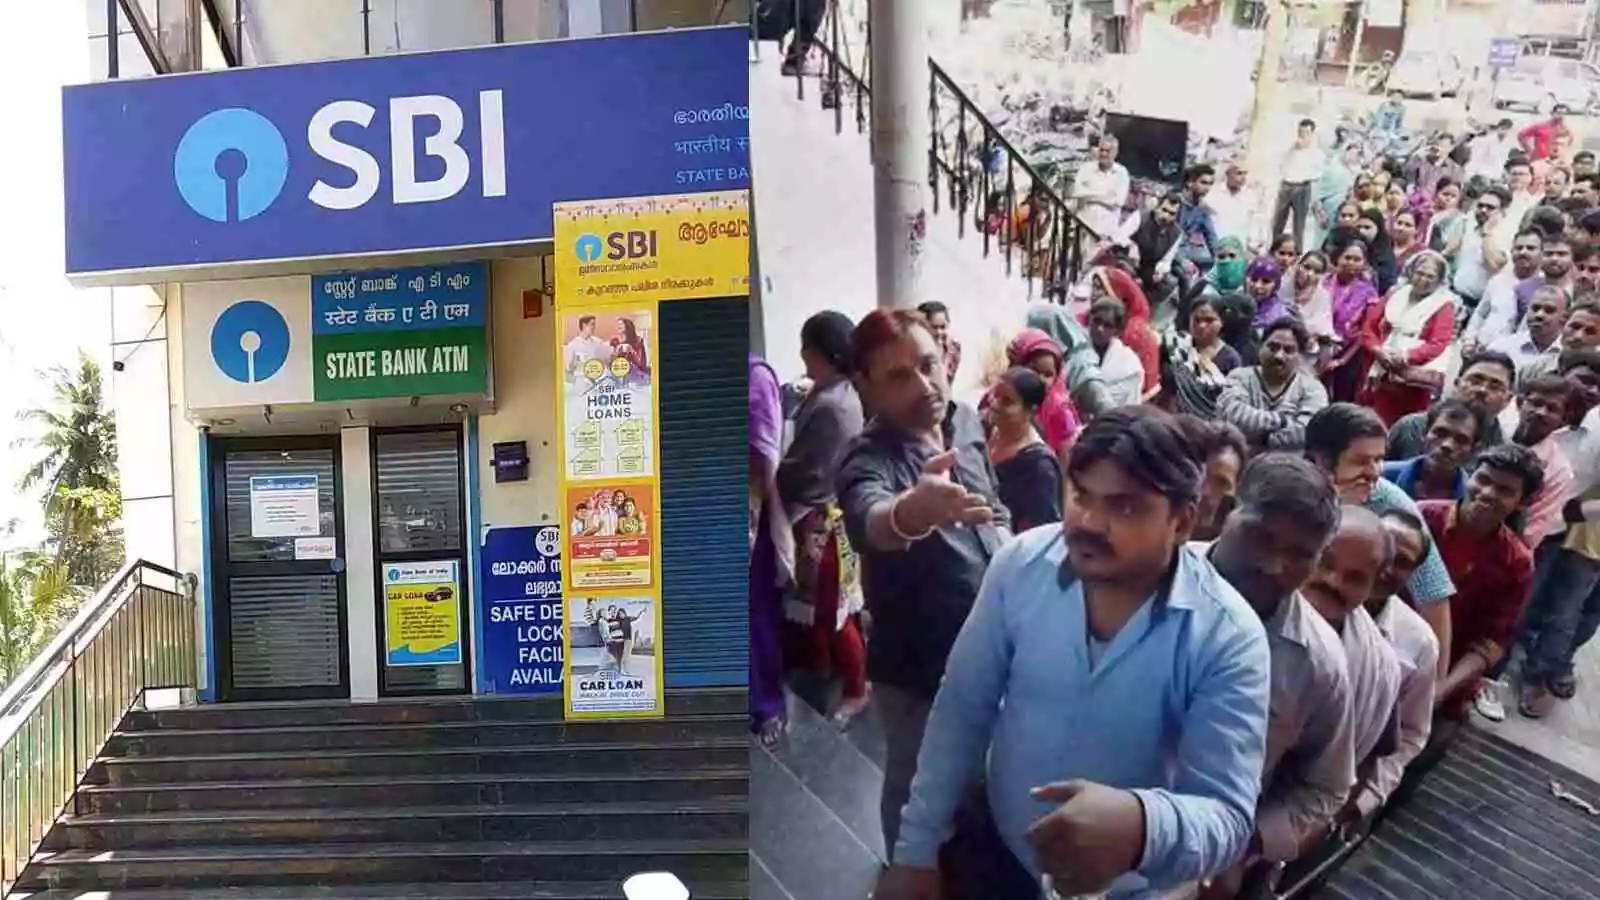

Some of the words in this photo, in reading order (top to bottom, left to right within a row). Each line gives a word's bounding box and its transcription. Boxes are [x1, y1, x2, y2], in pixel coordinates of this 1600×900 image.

[307, 88, 507, 210] SBI
[673, 134, 732, 154] भारतीय
[675, 168, 726, 184] STATE
[606, 230, 657, 261] SBI
[324, 306, 359, 326] स्टेट
[364, 302, 397, 323] बैंक
[402, 306, 414, 323] ए
[419, 299, 438, 320] टी
[444, 303, 470, 320] एम
[326, 350, 377, 380] STATE
[381, 347, 428, 376] BANK
[432, 344, 469, 373] ATM
[598, 385, 615, 394] SBI
[587, 392, 632, 407] HOME
[587, 407, 632, 420] LOANS
[490, 605, 535, 622] SAFE
[540, 604, 563, 620] DE
[518, 625, 563, 642] LOCK
[579, 681, 606, 691] CAR
[608, 679, 643, 690] LOAN
